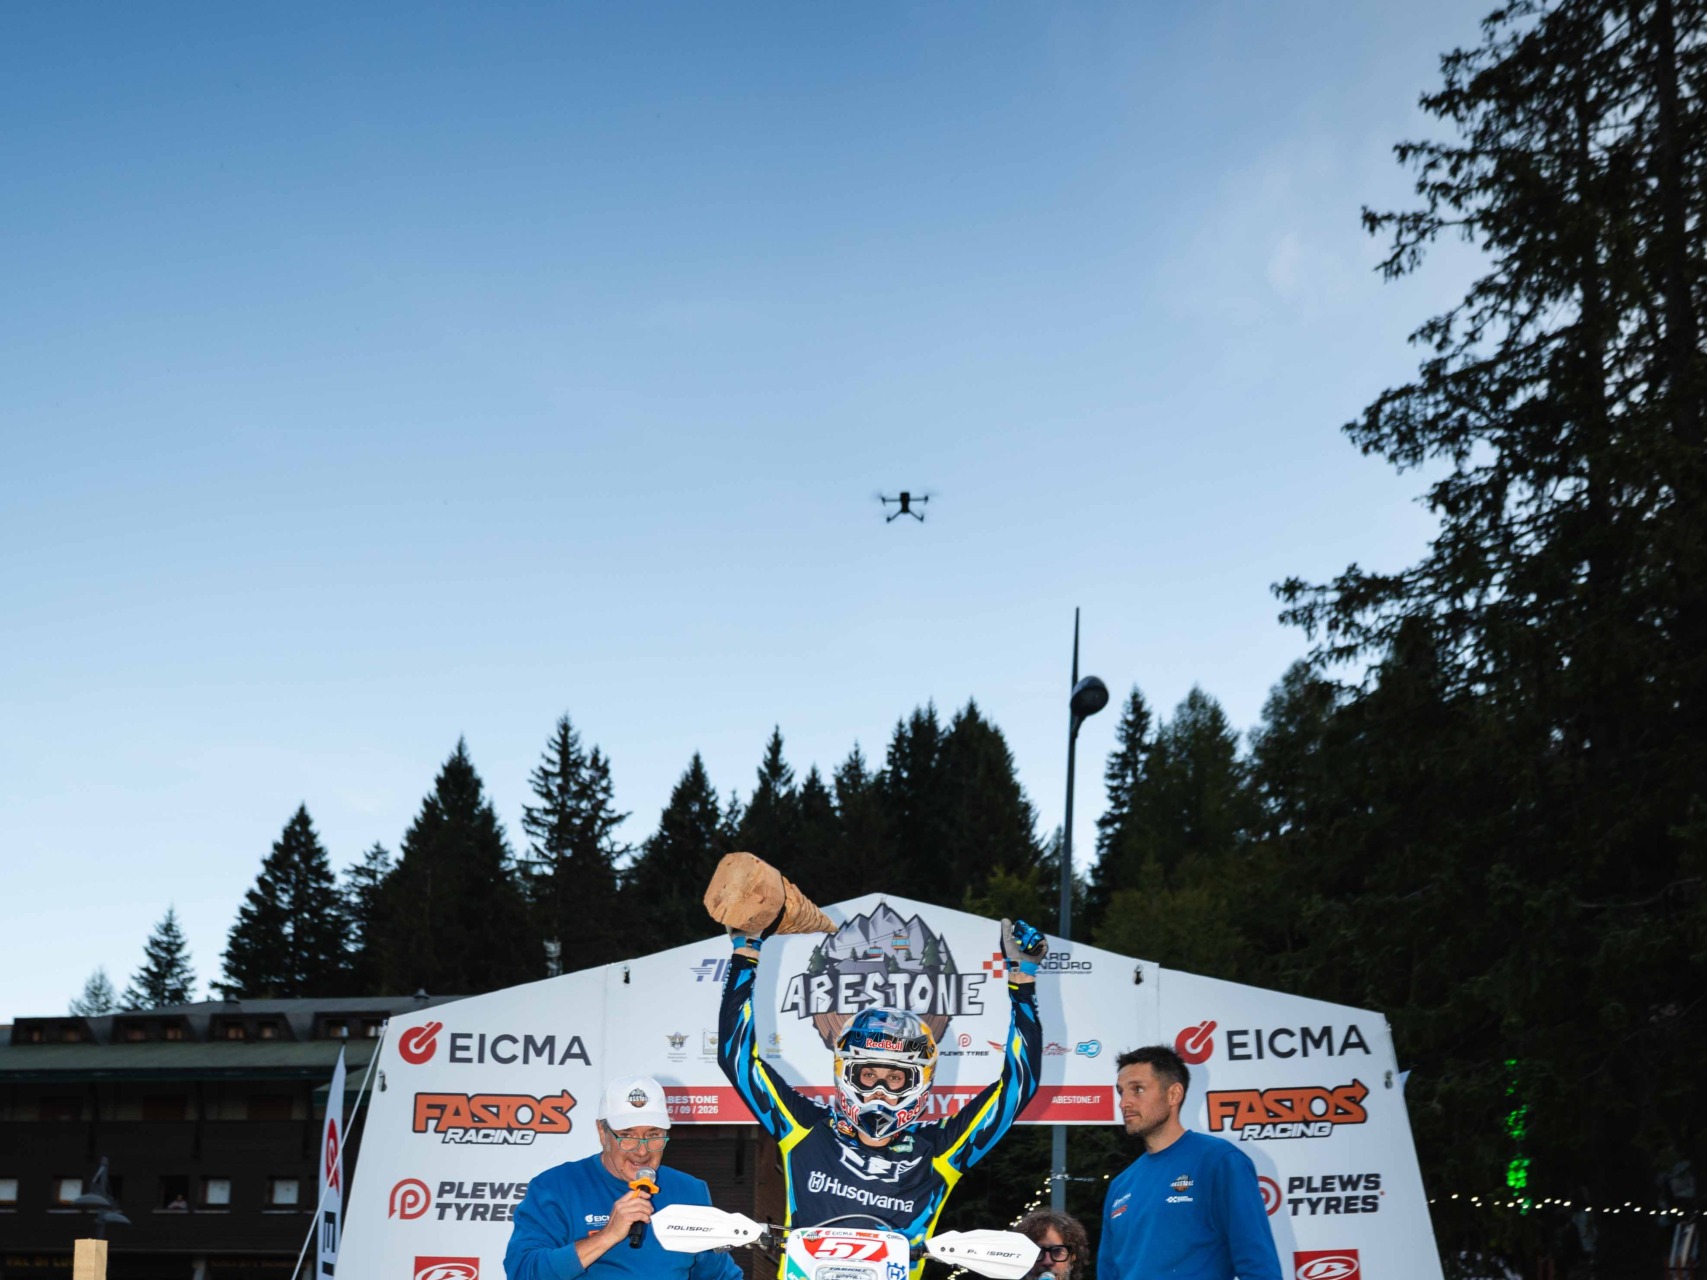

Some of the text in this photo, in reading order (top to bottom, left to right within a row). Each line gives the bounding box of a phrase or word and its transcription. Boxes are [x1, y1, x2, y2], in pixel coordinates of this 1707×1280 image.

[781, 972, 987, 1020] ABESTONE
[448, 1032, 592, 1066] EICMA
[865, 1038, 904, 1052] Red Bull
[1226, 1024, 1371, 1061] EICMA
[666, 1095, 719, 1104] BESTONE
[697, 1105, 719, 1114] 2026
[1051, 1095, 1101, 1104] ABESTONE.IT
[442, 1128, 537, 1145] RACING
[1240, 1121, 1333, 1141] RACING
[437, 1181, 528, 1200] PLEWS
[1288, 1173, 1381, 1194] PLEWS
[826, 1177, 914, 1214] Husqvarna
[1288, 1195, 1379, 1216] TYRES
[814, 1238, 885, 1260] 57
